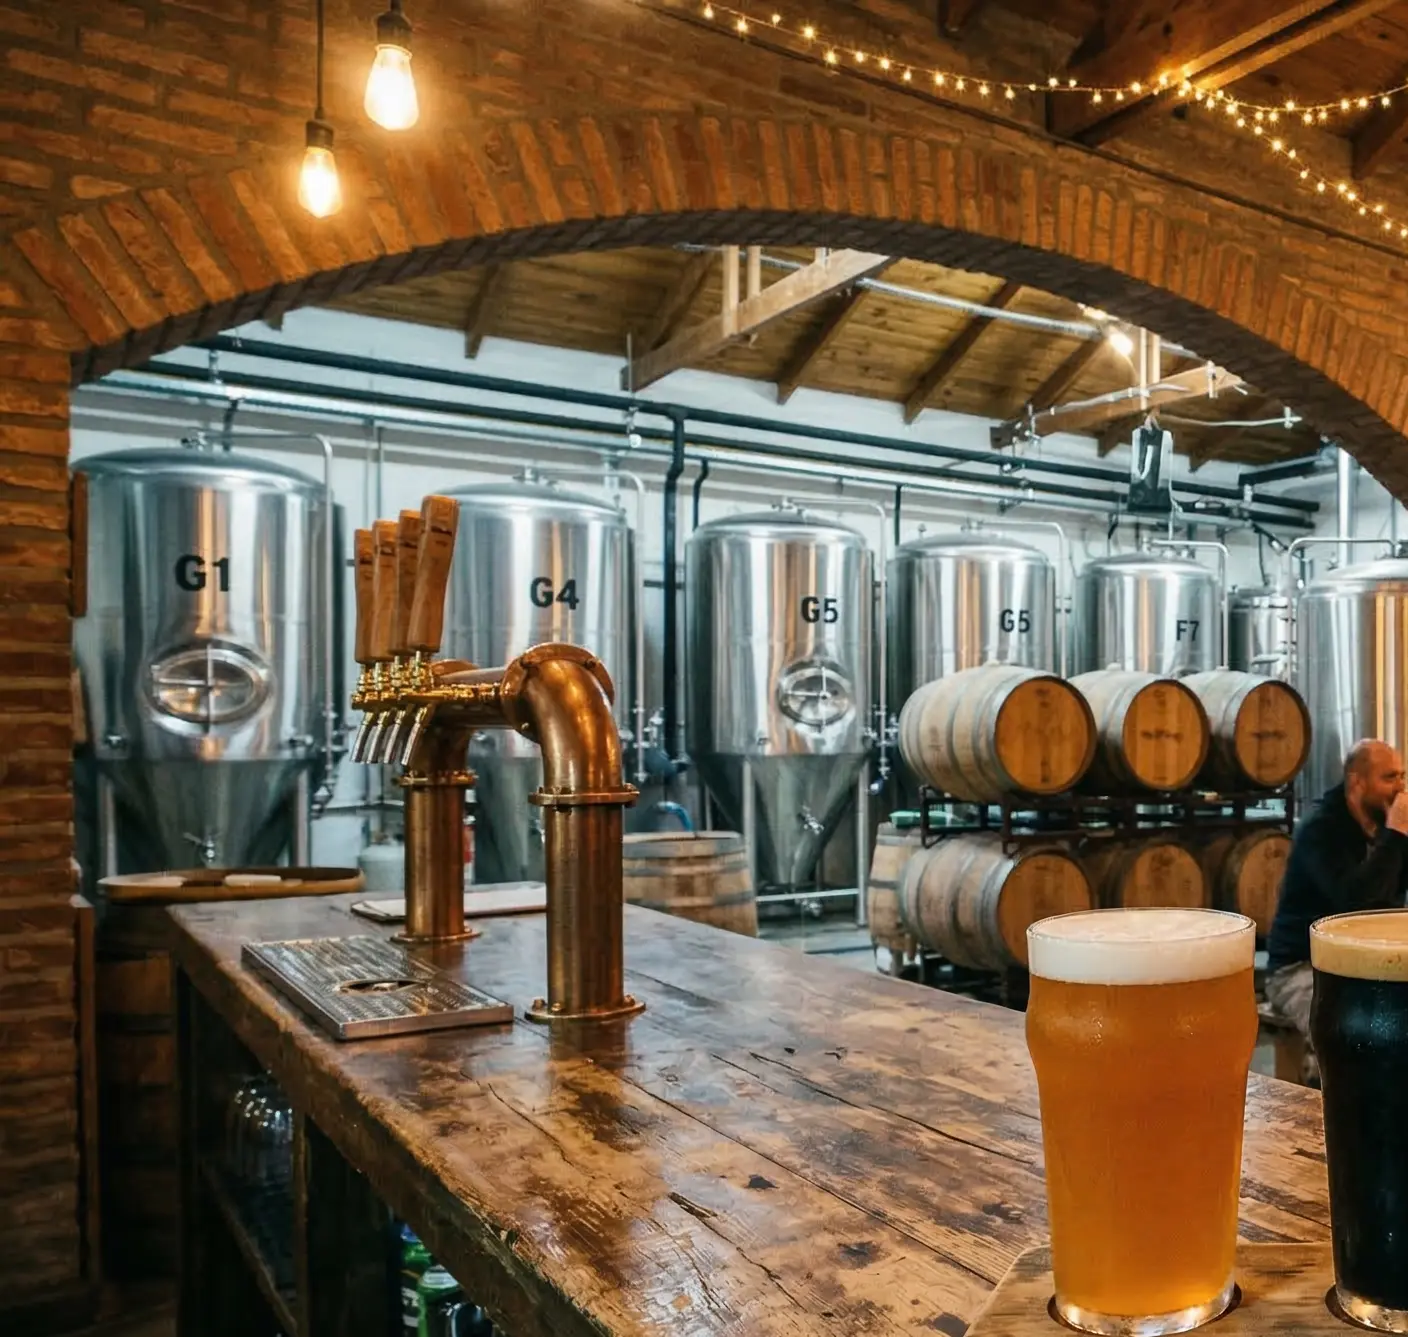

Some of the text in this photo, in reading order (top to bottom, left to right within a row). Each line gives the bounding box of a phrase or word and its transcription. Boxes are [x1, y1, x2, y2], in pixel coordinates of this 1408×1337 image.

[174, 554, 230, 592] G1
[530, 576, 579, 610] G4
[801, 596, 838, 623] G5
[1000, 609, 1031, 633] G5
[1176, 620, 1200, 642] F7
